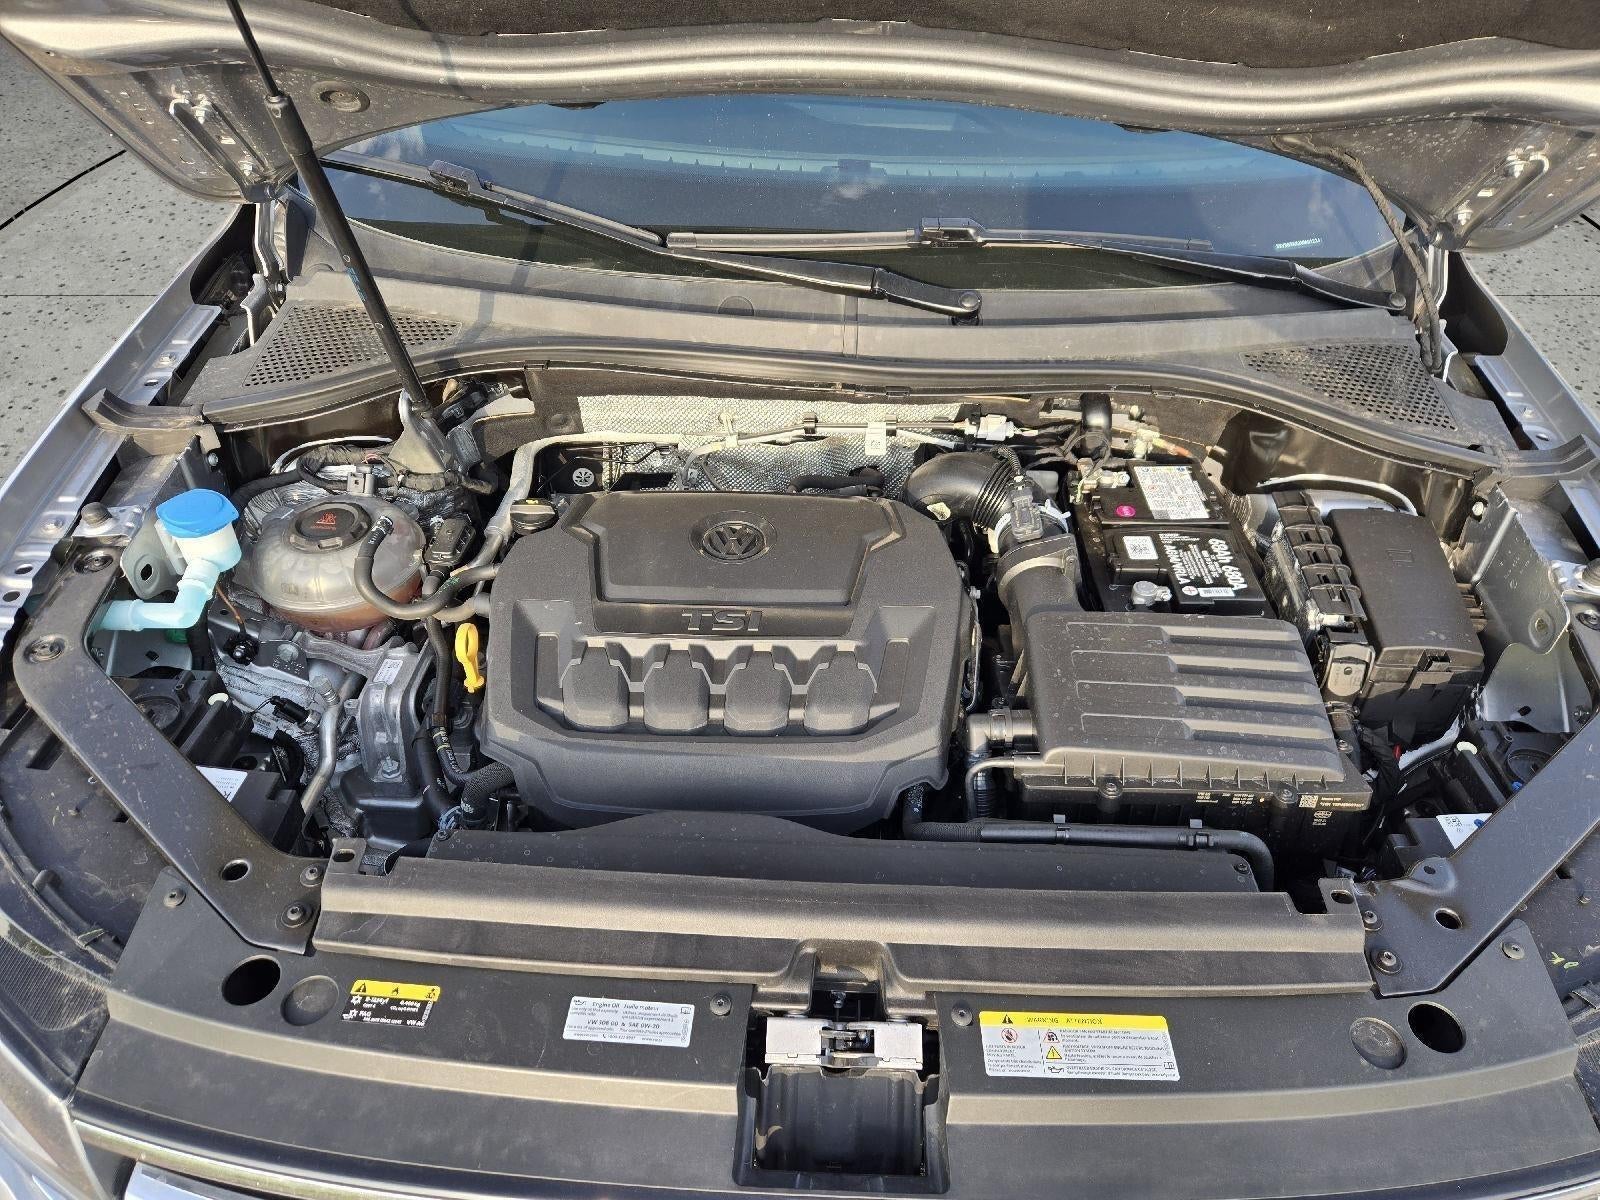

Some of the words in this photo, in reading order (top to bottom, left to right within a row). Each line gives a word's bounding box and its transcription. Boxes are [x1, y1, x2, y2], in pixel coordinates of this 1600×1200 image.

[1208, 538, 1234, 563] 68Ah
[1221, 565, 1248, 590] 680A
[682, 610, 763, 631] TSI
